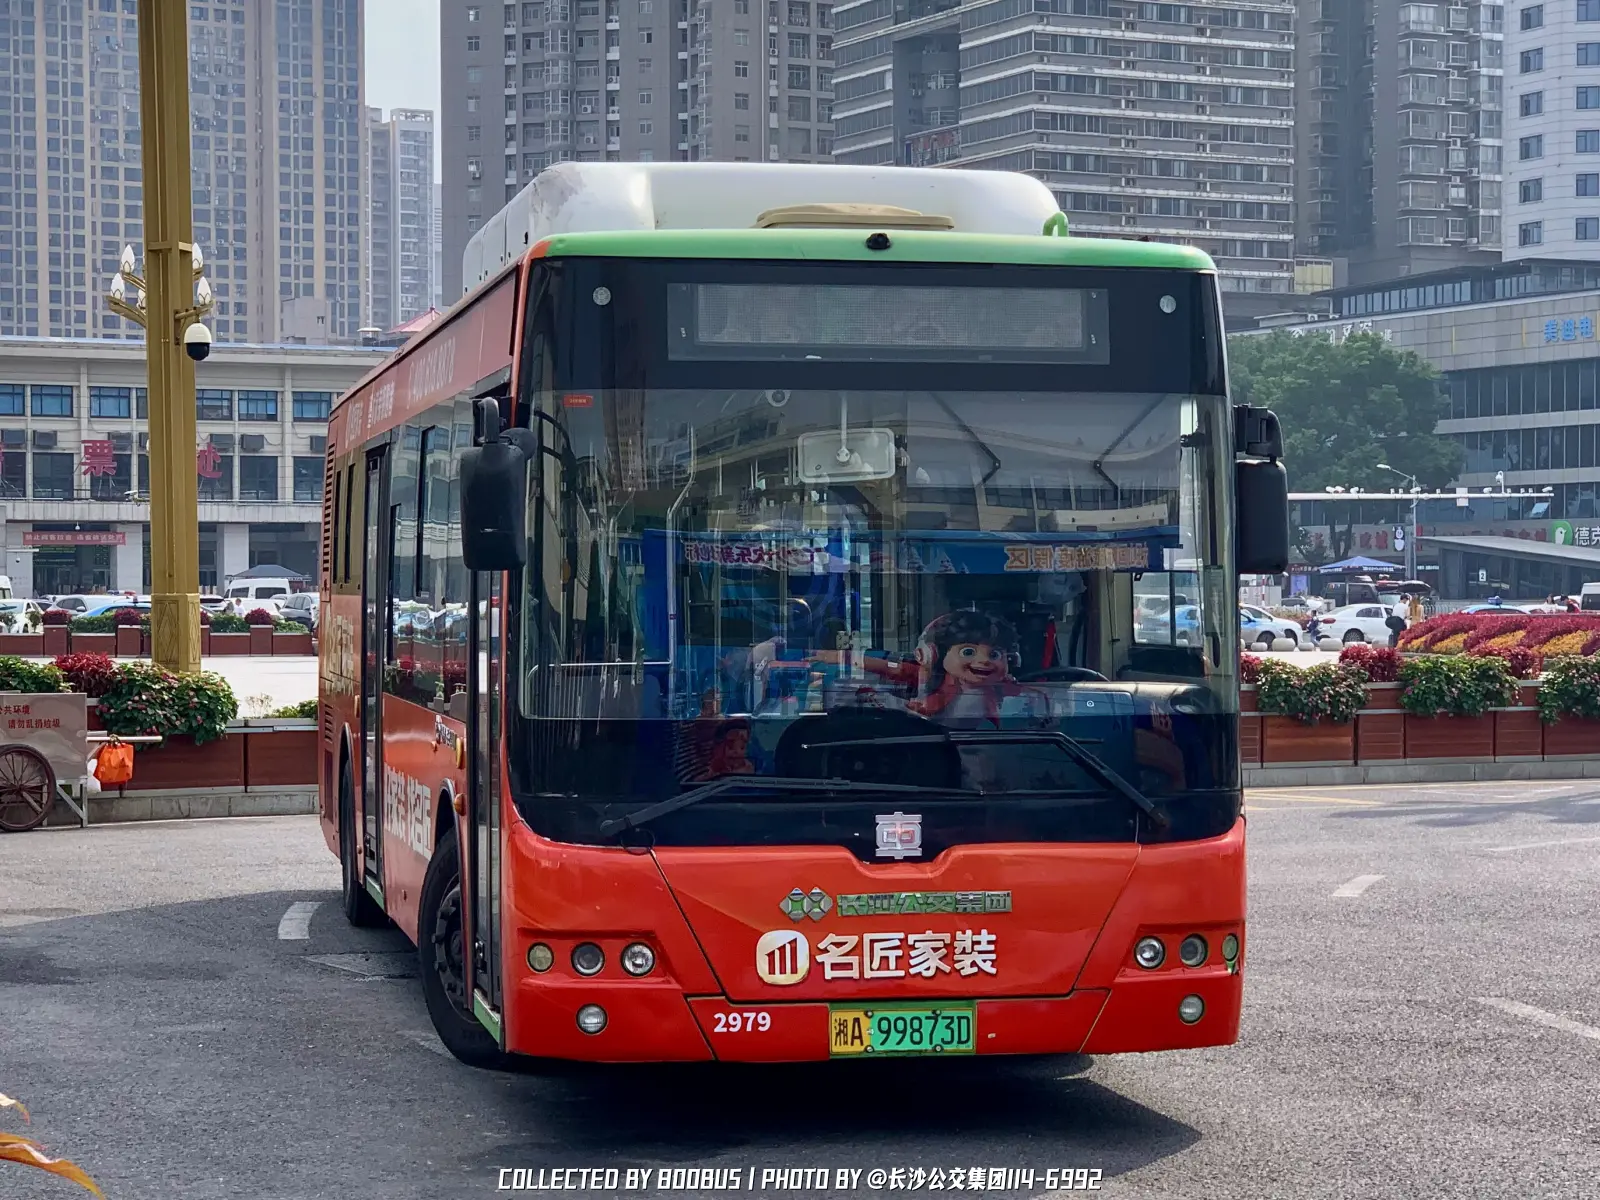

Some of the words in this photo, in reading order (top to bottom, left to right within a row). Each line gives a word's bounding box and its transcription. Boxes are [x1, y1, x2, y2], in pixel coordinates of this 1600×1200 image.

[837, 891, 1013, 915] 长沙公交集团
[816, 929, 998, 980] 名匠家装
[713, 1011, 772, 1033] 2979
